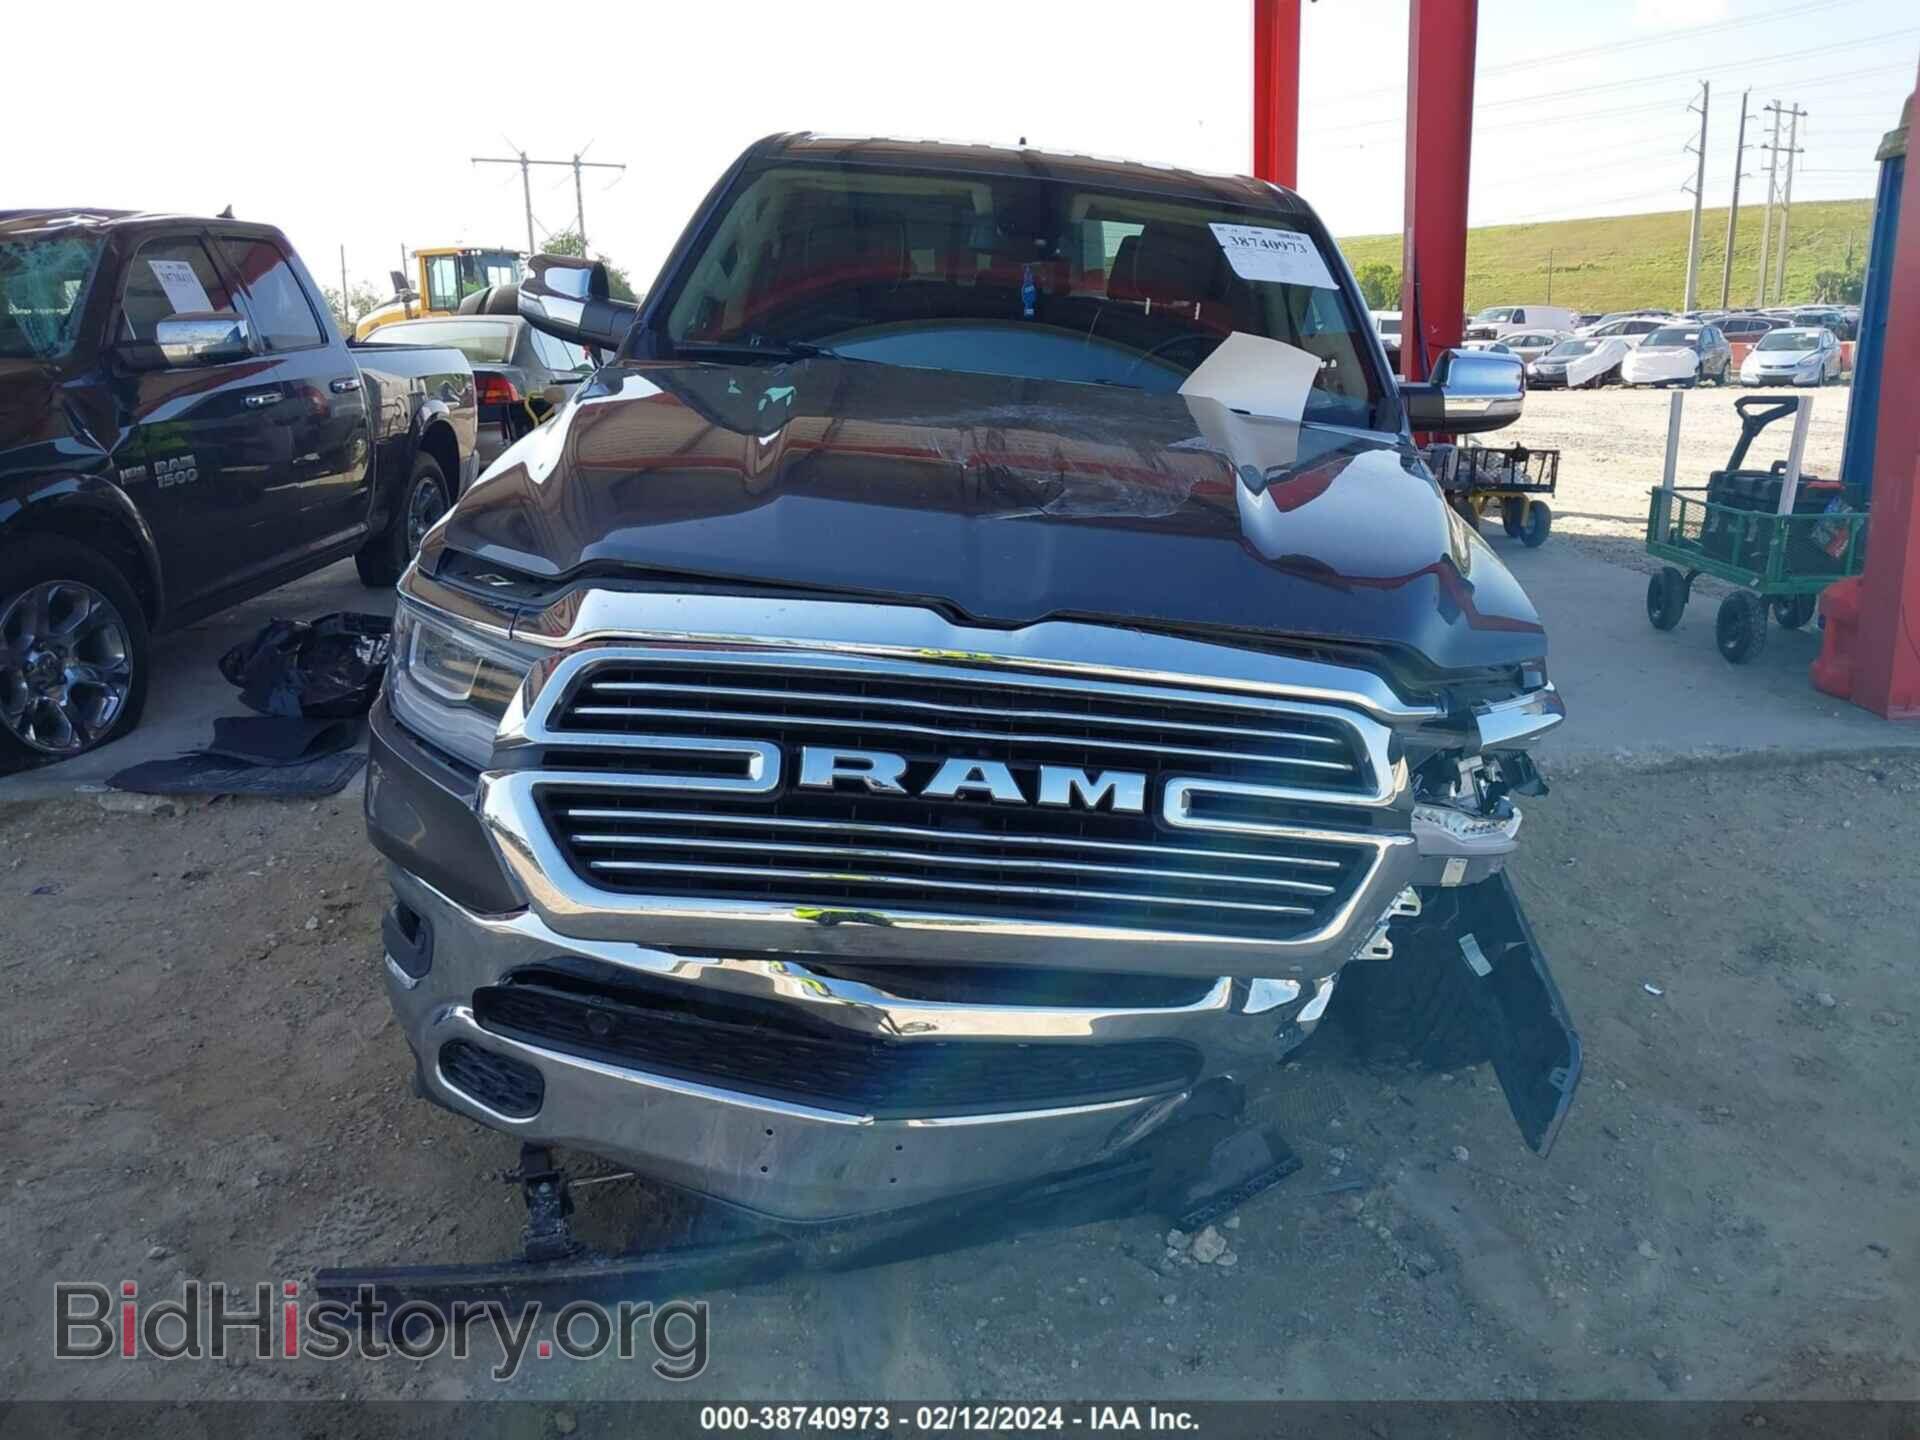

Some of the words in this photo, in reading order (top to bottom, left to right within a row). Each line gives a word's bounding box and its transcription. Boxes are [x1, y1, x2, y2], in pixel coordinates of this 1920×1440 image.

[1228, 235, 1308, 254] 38740973
[154, 454, 196, 475] RAM
[156, 468, 198, 488] 1500
[799, 746, 1147, 814] RAM
